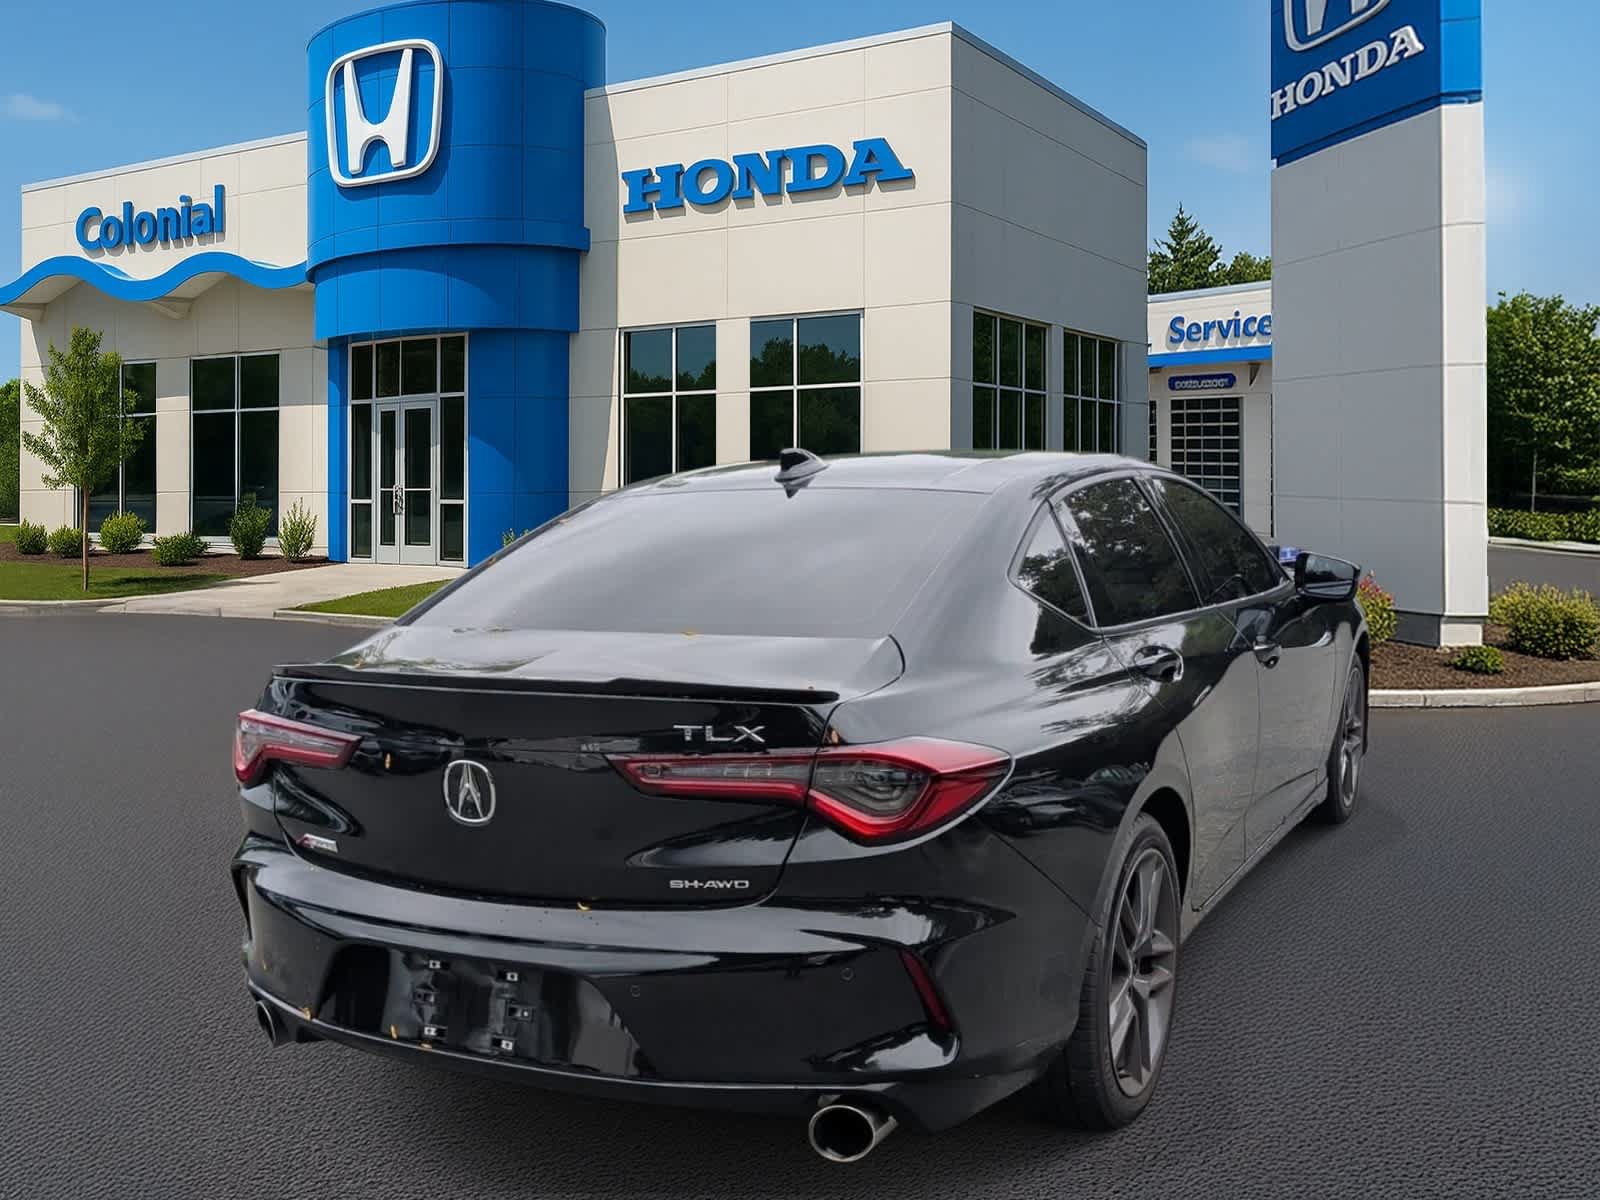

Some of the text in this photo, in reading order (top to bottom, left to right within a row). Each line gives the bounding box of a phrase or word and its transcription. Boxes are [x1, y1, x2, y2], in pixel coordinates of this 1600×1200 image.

[1271, 25, 1425, 120] HONDA
[621, 137, 914, 213] HONDA
[76, 184, 225, 251] Colonial
[1169, 310, 1272, 344] Service
[673, 725, 765, 742] TLX
[669, 879, 749, 889] SH-AWD
